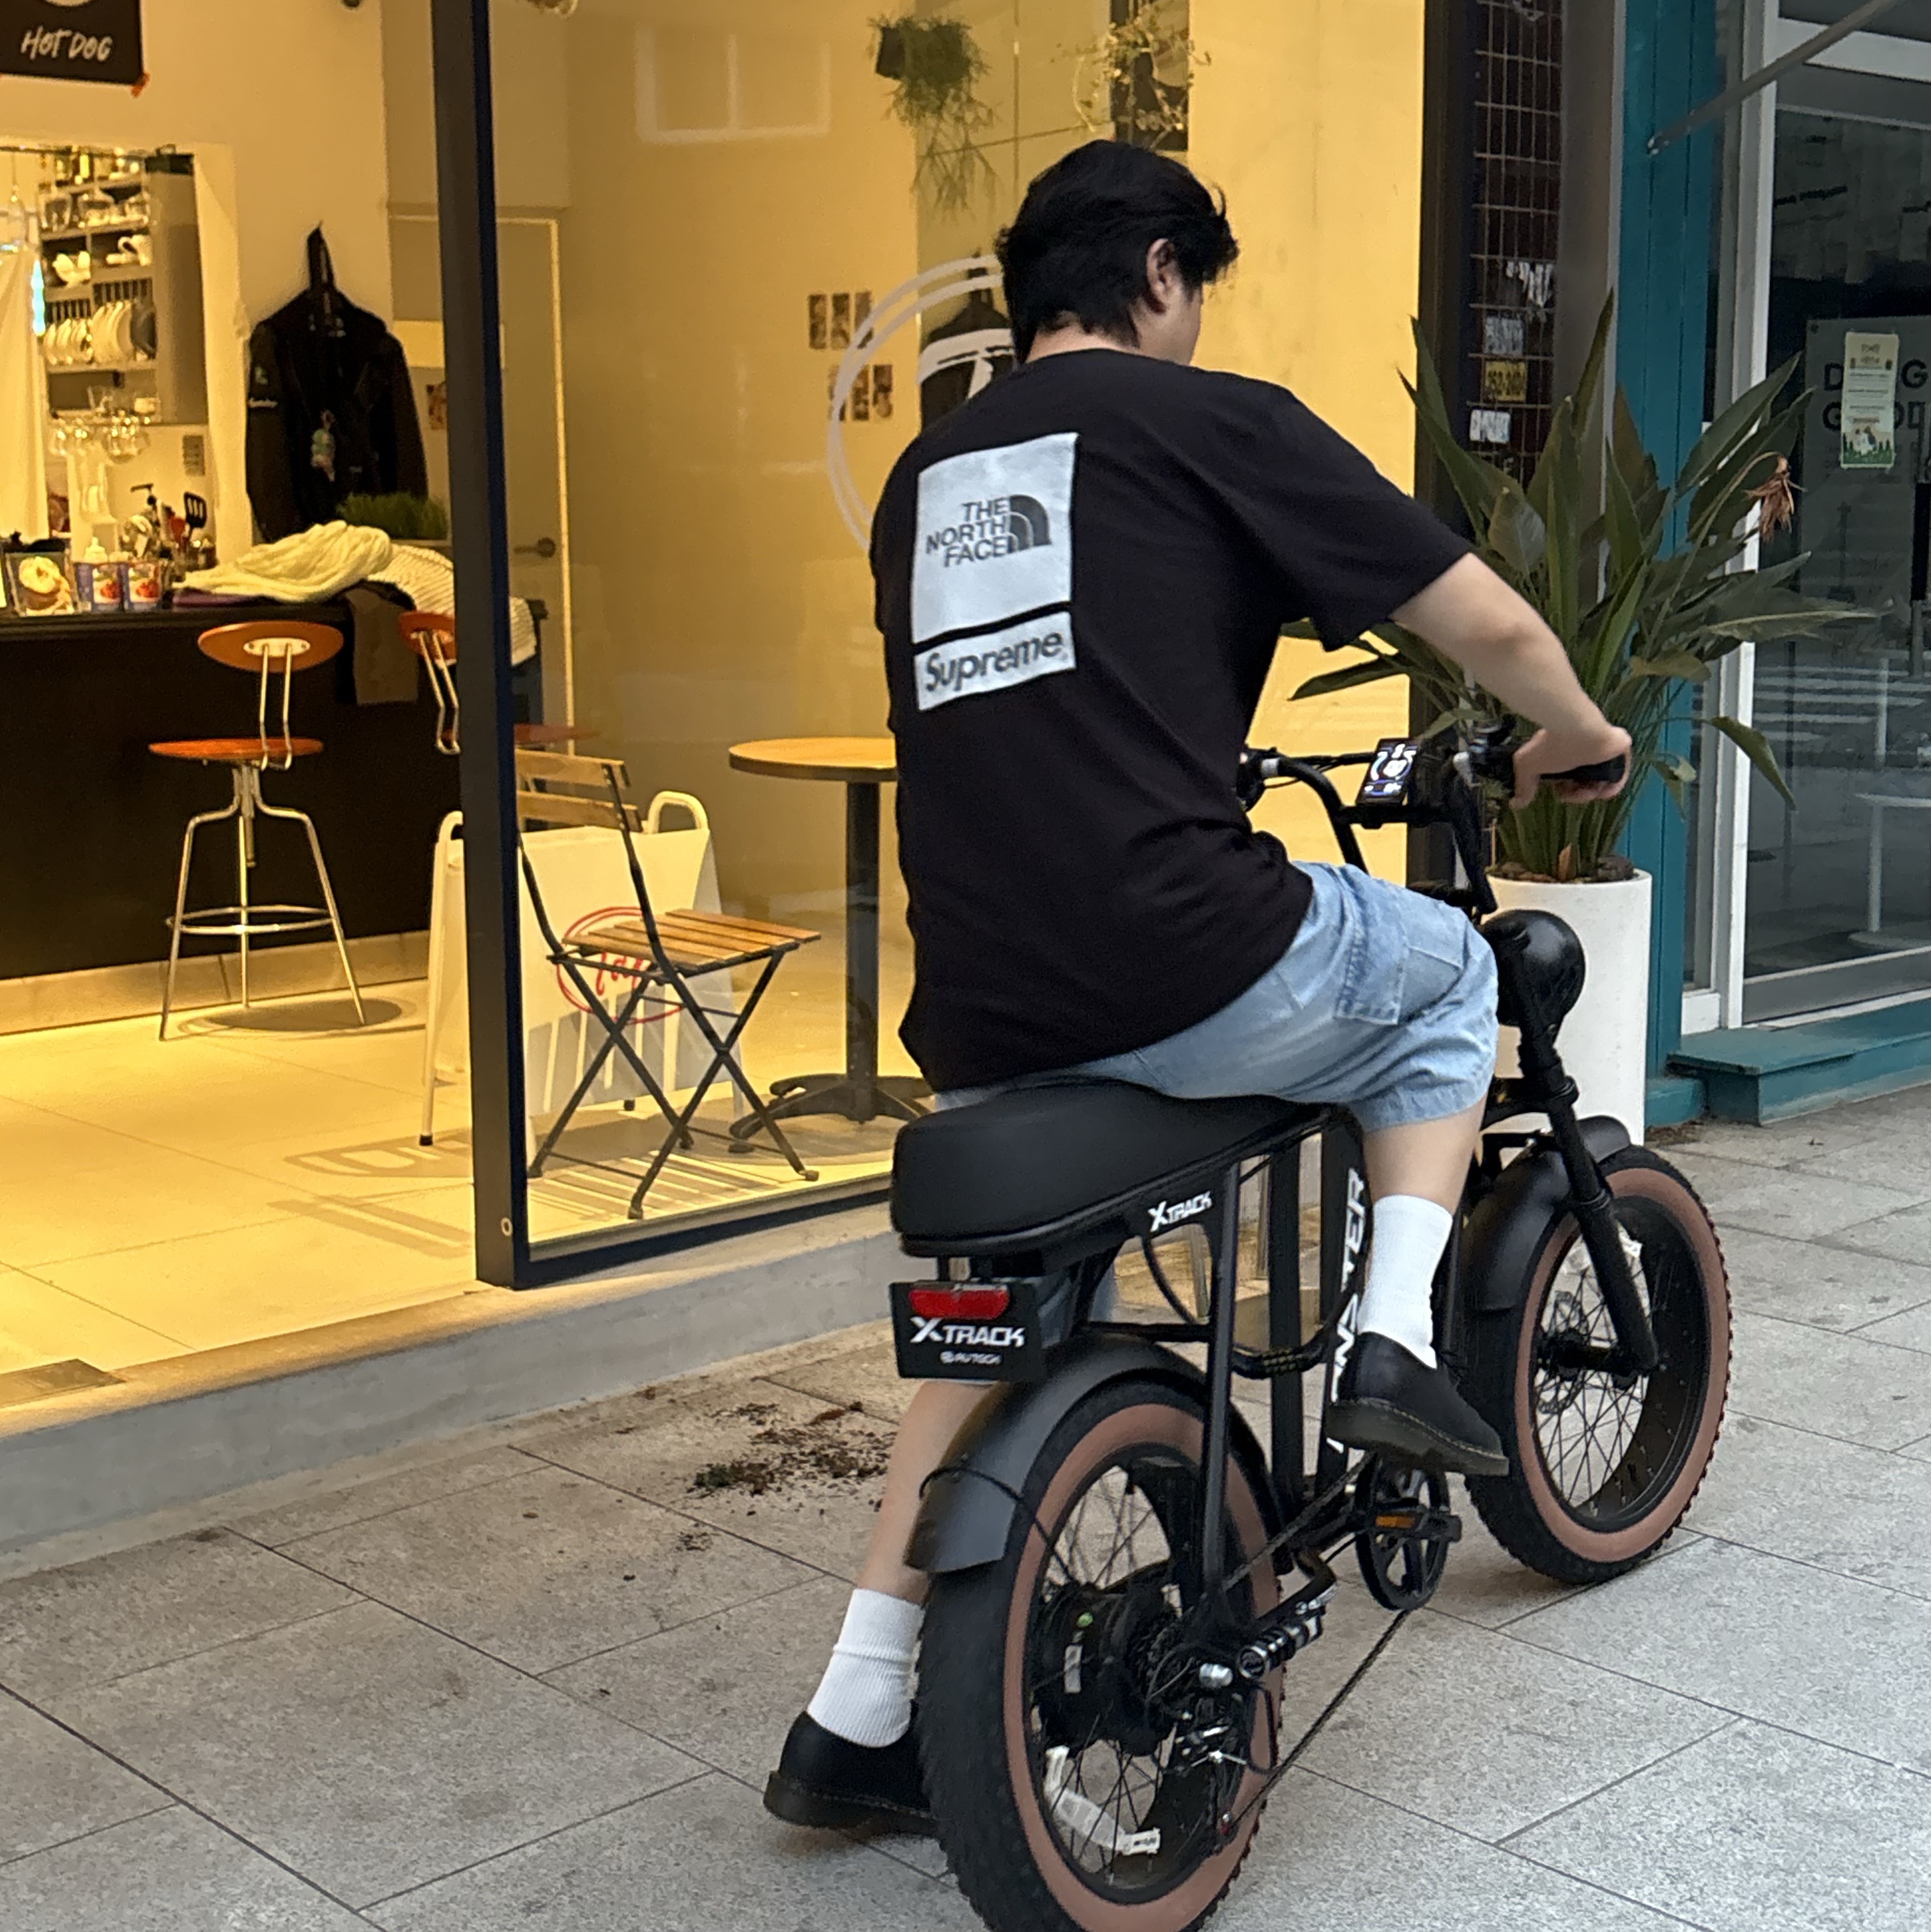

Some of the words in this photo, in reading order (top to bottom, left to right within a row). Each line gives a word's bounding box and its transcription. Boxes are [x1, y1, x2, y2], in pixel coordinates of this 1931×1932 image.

[20, 25, 72, 60] HOT
[68, 32, 114, 62] DOG
[961, 496, 1011, 522] THE
[926, 515, 1007, 555] NORTH
[943, 535, 1008, 568] FACE
[926, 632, 1064, 691] Supreme
